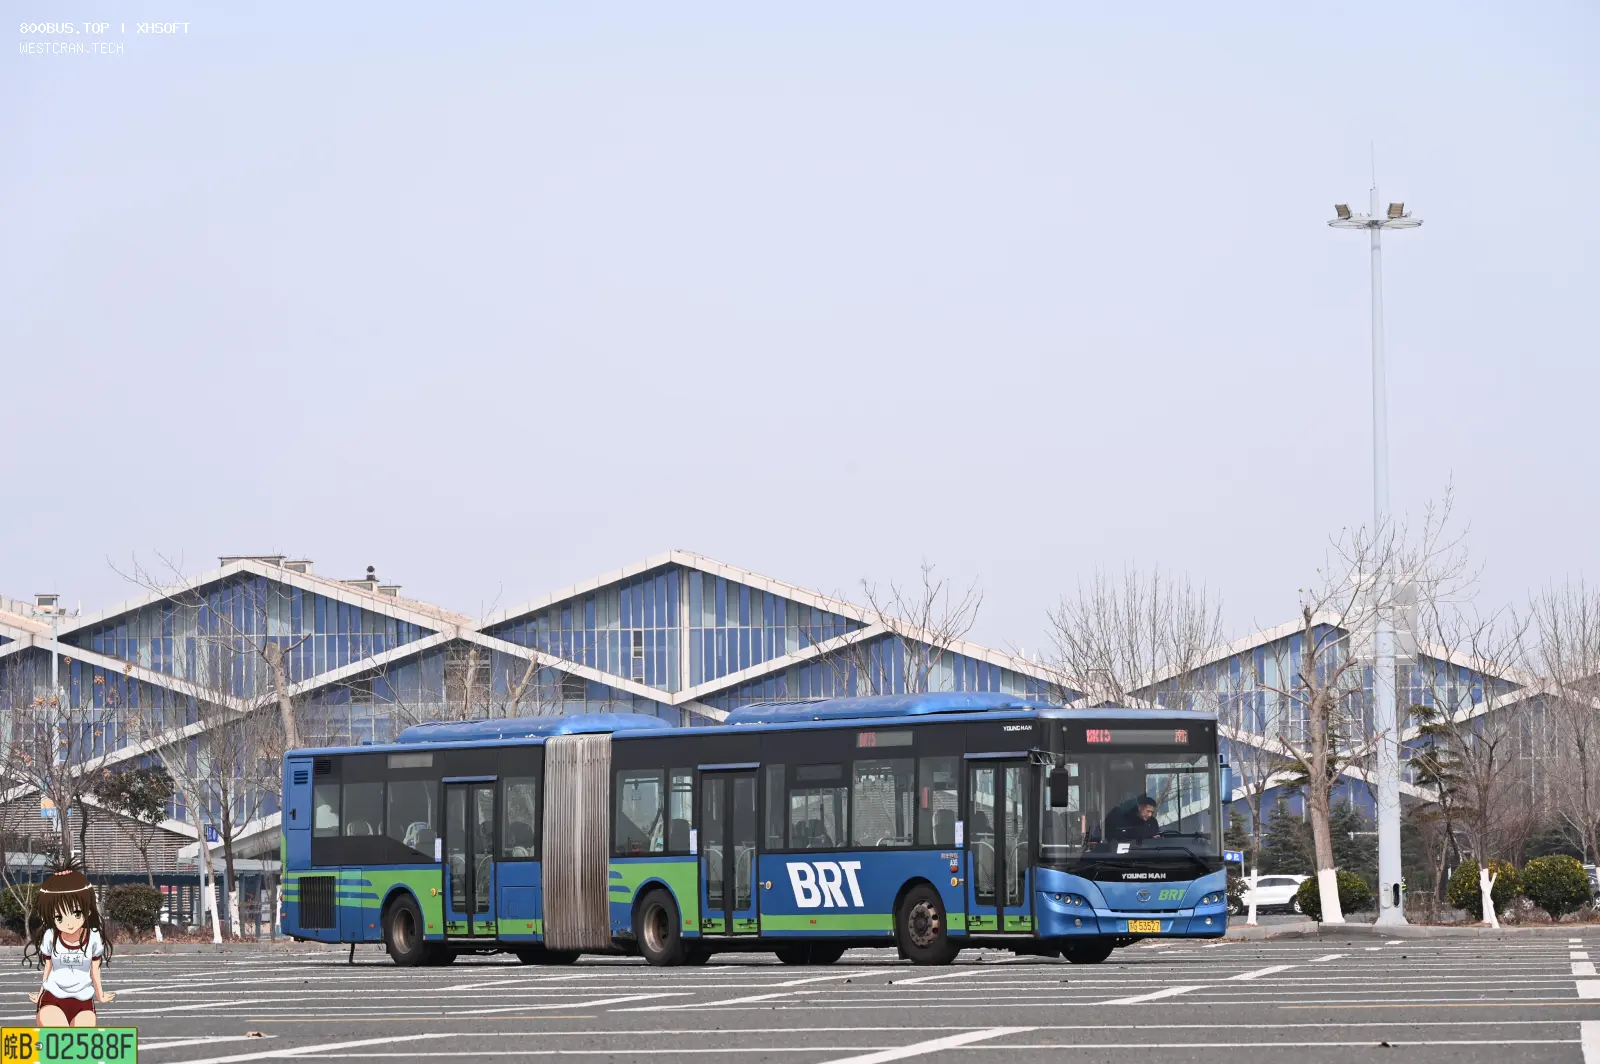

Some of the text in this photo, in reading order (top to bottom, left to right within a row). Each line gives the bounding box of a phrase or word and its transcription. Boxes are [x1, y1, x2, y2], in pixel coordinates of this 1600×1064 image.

[786, 860, 865, 908] BRT
[1158, 888, 1186, 901] BRT
[1139, 921, 1160, 931] 53527
